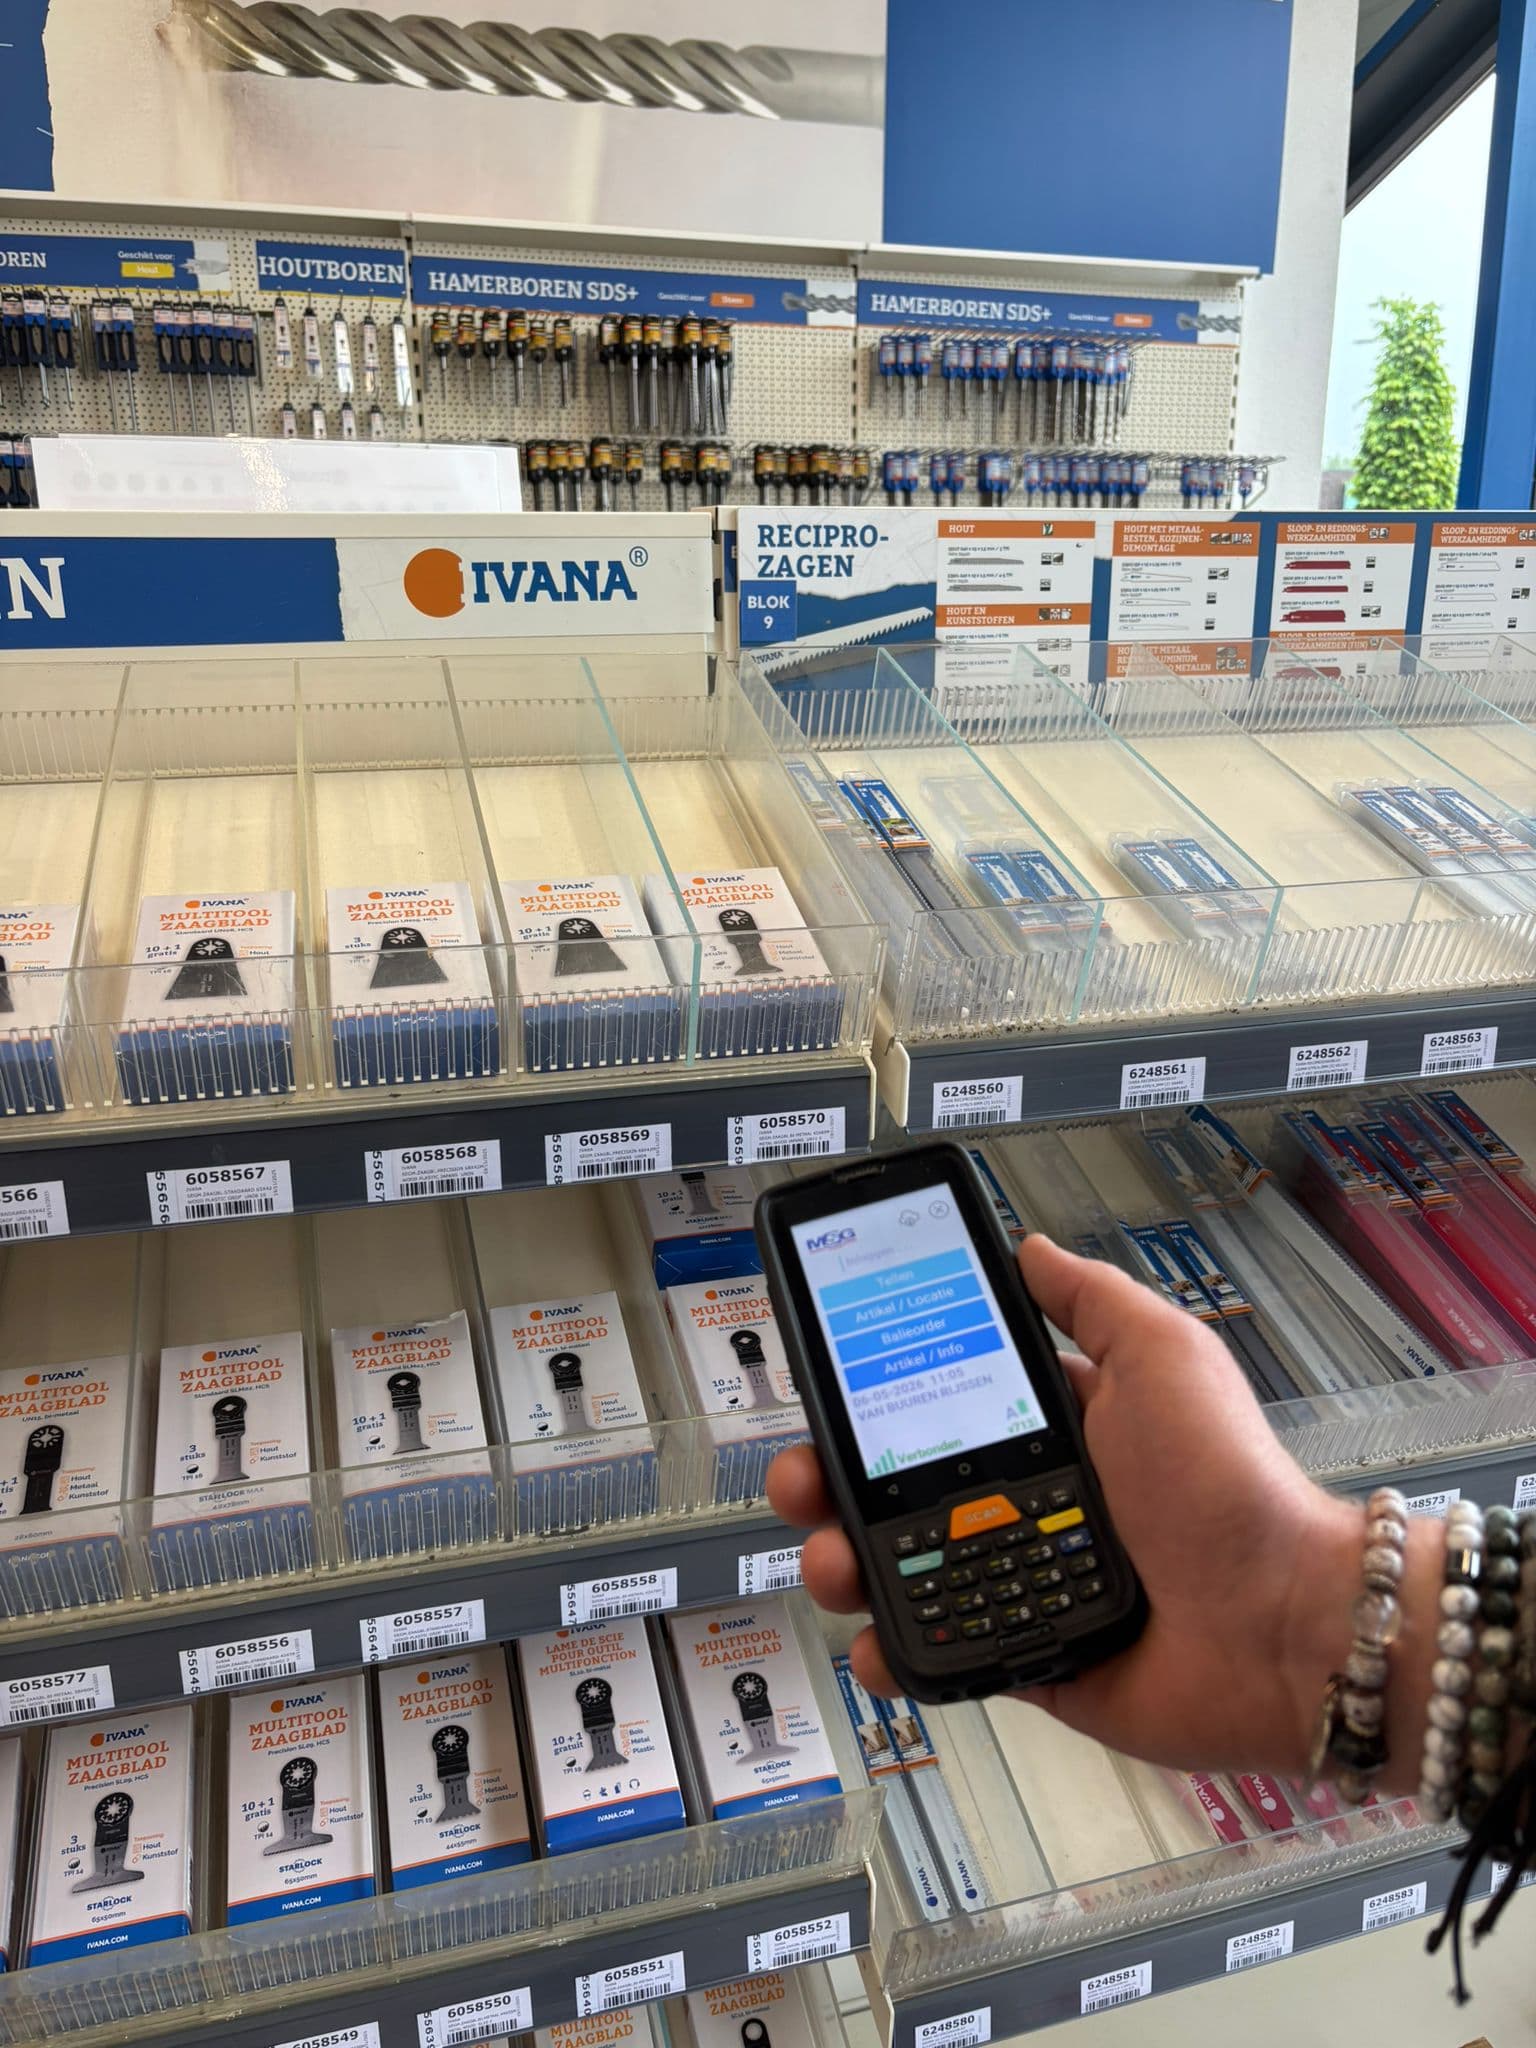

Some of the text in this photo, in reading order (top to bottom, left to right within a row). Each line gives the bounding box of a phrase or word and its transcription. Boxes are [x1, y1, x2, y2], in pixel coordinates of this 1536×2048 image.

[258, 256, 404, 285] HOUTBOREN
[428, 271, 584, 300] HAMERBOREN
[586, 282, 639, 302] SDS+
[871, 293, 1053, 323] HAMERBOREN SDS+
[757, 524, 889, 549] RECIPRO-
[948, 524, 975, 534] HOUT
[1123, 525, 1167, 533] HOUT MET
[1315, 525, 1326, 533] EN
[1467, 526, 1478, 534] EN
[1286, 533, 1356, 542] WERKZAAMHEDEN
[1440, 534, 1507, 543] WERKZAAMHEDEN
[1122, 544, 1176, 552] DEMONTAGE
[757, 554, 855, 579] ZAGEN
[747, 595, 790, 610] BLOK
[946, 606, 986, 615] HOUT EN
[763, 615, 774, 629] 9
[946, 616, 1015, 625] KUNSTSTOFFEN
[519, 891, 621, 904] MULTITOOL
[682, 883, 774, 897] MULTITOOL
[346, 899, 455, 913] MULTITOOL
[523, 899, 621, 912] ZAAGBLAD
[685, 892, 775, 906] ZAAGBLAD
[159, 909, 273, 921] MULTITOOL
[350, 907, 453, 921] ZAAGBLAD
[160, 919, 271, 931] ZAAGBLAD
[522, 932, 550, 940] gratis
[145, 945, 160, 953] 10
[147, 950, 178, 959] gratis
[1430, 1032, 1483, 1047] 6248563
[1296, 1046, 1352, 1061] 6248562
[1129, 1063, 1188, 1079] 6248561
[941, 1081, 1004, 1098] 6248560
[759, 1112, 826, 1129] 6058570
[579, 1129, 650, 1147] 6058569
[401, 1145, 478, 1164] 6058568
[185, 1166, 265, 1186] 6058567
[855, 1286, 955, 1324] Artikel Locatie
[511, 1315, 609, 1339] MULTITOOL
[880, 1317, 947, 1346] Balieorder
[516, 1327, 609, 1350] ZAAGBLAD
[351, 1337, 453, 1359] MULTITOOL
[355, 1349, 452, 1370] ZAAGBLAD
[884, 1342, 965, 1377] Artikel Info
[179, 1358, 284, 1382] MULTITOOL
[181, 1370, 283, 1394] ZAAGBLAD
[717, 1384, 742, 1395] gratis
[0, 1381, 110, 1405] MULTITOOL
[0, 1394, 106, 1418] ZAAGBLAD
[535, 1403, 543, 1412] 3
[857, 1390, 938, 1423] VAN BUUREN
[351, 1415, 367, 1426] 10
[437, 1418, 456, 1427] Hout
[528, 1410, 553, 1420] stuks
[603, 1411, 639, 1422] Kunststof
[355, 1421, 384, 1433] gratis
[438, 1425, 474, 1435] Kunststof
[188, 1444, 197, 1453] 3
[260, 1446, 279, 1454] Hout
[898, 1437, 963, 1464] Verbonden
[179, 1452, 206, 1463] stuks
[260, 1452, 297, 1463] Kunststof
[70, 1474, 91, 1482] Hout
[68, 1488, 109, 1500] Kunststof
[591, 1573, 658, 1594] 6058558
[393, 1606, 463, 1627] 6058557
[215, 1636, 290, 1660] 6058556
[545, 1632, 625, 1656] LAME DE SCIE
[694, 1628, 781, 1655] MULTITOOL
[551, 1641, 623, 1664] POUR OUTIL
[700, 1641, 783, 1668] ZAAGBLAD
[539, 1649, 638, 1677] MULTIFONCTION
[8, 1672, 87, 1694] 6058577
[398, 1678, 494, 1707] MULTITOOL
[402, 1692, 493, 1722] ZAAGBLAD
[248, 1706, 348, 1737] MULTITOOL
[723, 1719, 731, 1728] 3
[251, 1721, 346, 1752] ZAAGBLAD
[552, 1731, 583, 1747] 10 1
[629, 1728, 644, 1736] Bois
[718, 1726, 741, 1738] stuks
[789, 1727, 820, 1738] Kunststof
[65, 1740, 170, 1771] MULTITOOL
[553, 1740, 584, 1756] gratuit
[632, 1744, 656, 1755] Plastic
[67, 1755, 168, 1786] ZAAGBLAD
[753, 1759, 792, 1775] STARLOCK
[83, 1780, 115, 1792] Precision
[482, 1776, 501, 1785] Hout
[416, 1783, 424, 1794] 3
[484, 1783, 509, 1795] Metaal
[241, 1797, 275, 1813] 10 1
[408, 1792, 433, 1805] stuks
[485, 1791, 519, 1805] Kunststof
[764, 1793, 799, 1808] IVANA.COM
[244, 1808, 272, 1822] gratis
[329, 1804, 347, 1814] Hout
[597, 1808, 635, 1823] IVANA.COM
[329, 1812, 364, 1825] Kunststof
[439, 1823, 481, 1839] STARLOCK
[70, 1835, 78, 1845] 3
[142, 1840, 161, 1851] Hout
[60, 1843, 87, 1856] stuks
[142, 1847, 179, 1861] Kunststof
[278, 1858, 323, 1873] STARLOCK
[444, 1860, 483, 1875] IVANA.COM
[917, 1867, 933, 1897] IVANA
[956, 1860, 971, 1890] IVANA
[86, 1895, 133, 1912] STARLOCK
[281, 1895, 322, 1911] IVANA.COM
[1369, 1888, 1414, 1909] 6248583
[774, 1919, 833, 1942] 6058552
[1233, 1927, 1281, 1949] 6248582
[86, 1934, 129, 1950] IVANA.COM
[604, 1959, 666, 1982] 6058551
[704, 1973, 785, 2002] MULTITOOL
[1087, 1969, 1137, 1991] 6248581
[447, 1994, 512, 2018] 6058550
[709, 1987, 786, 2016] ZAAGBLAD
[550, 2009, 634, 2039] MULTITOOL
[922, 2014, 975, 2037] 6248580
